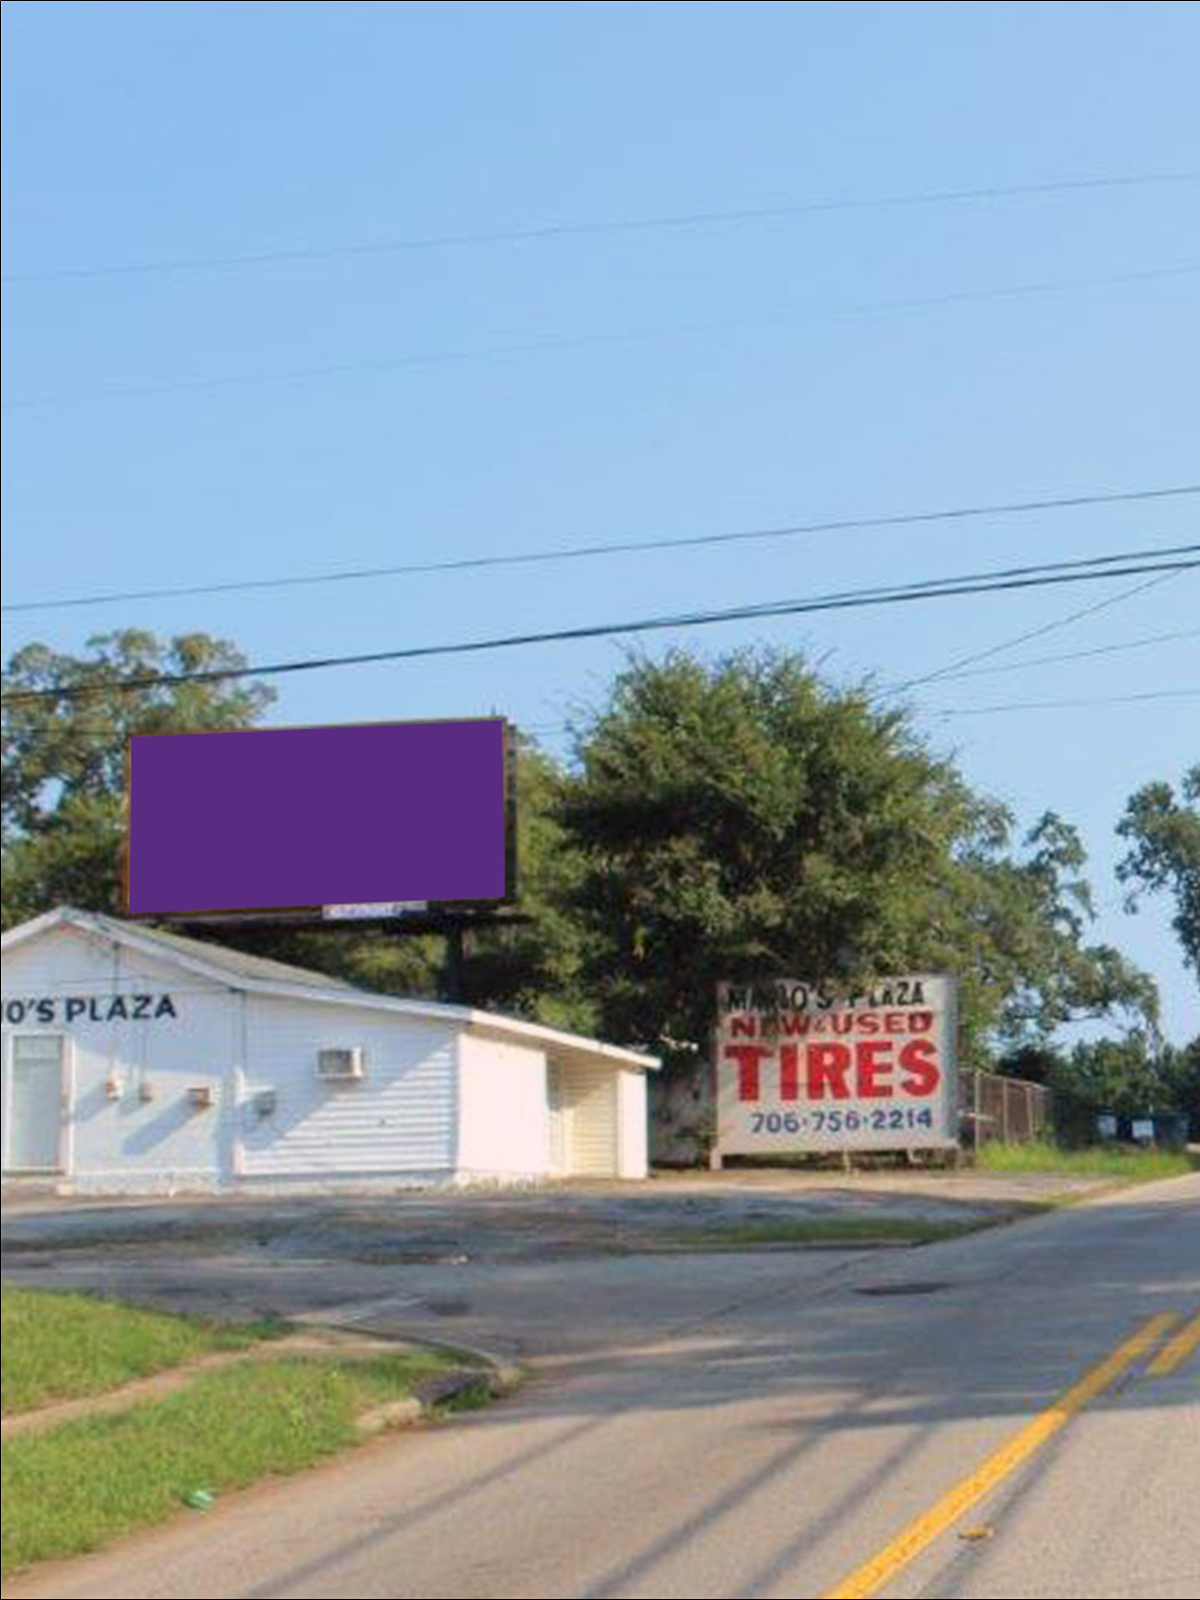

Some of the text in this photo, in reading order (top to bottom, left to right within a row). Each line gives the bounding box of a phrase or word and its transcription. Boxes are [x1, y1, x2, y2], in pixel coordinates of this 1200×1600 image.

[65, 994, 177, 1022] PLAZA
[730, 1011, 812, 1038] NW
[831, 1010, 935, 1035] USED
[724, 1039, 941, 1102] TIRES
